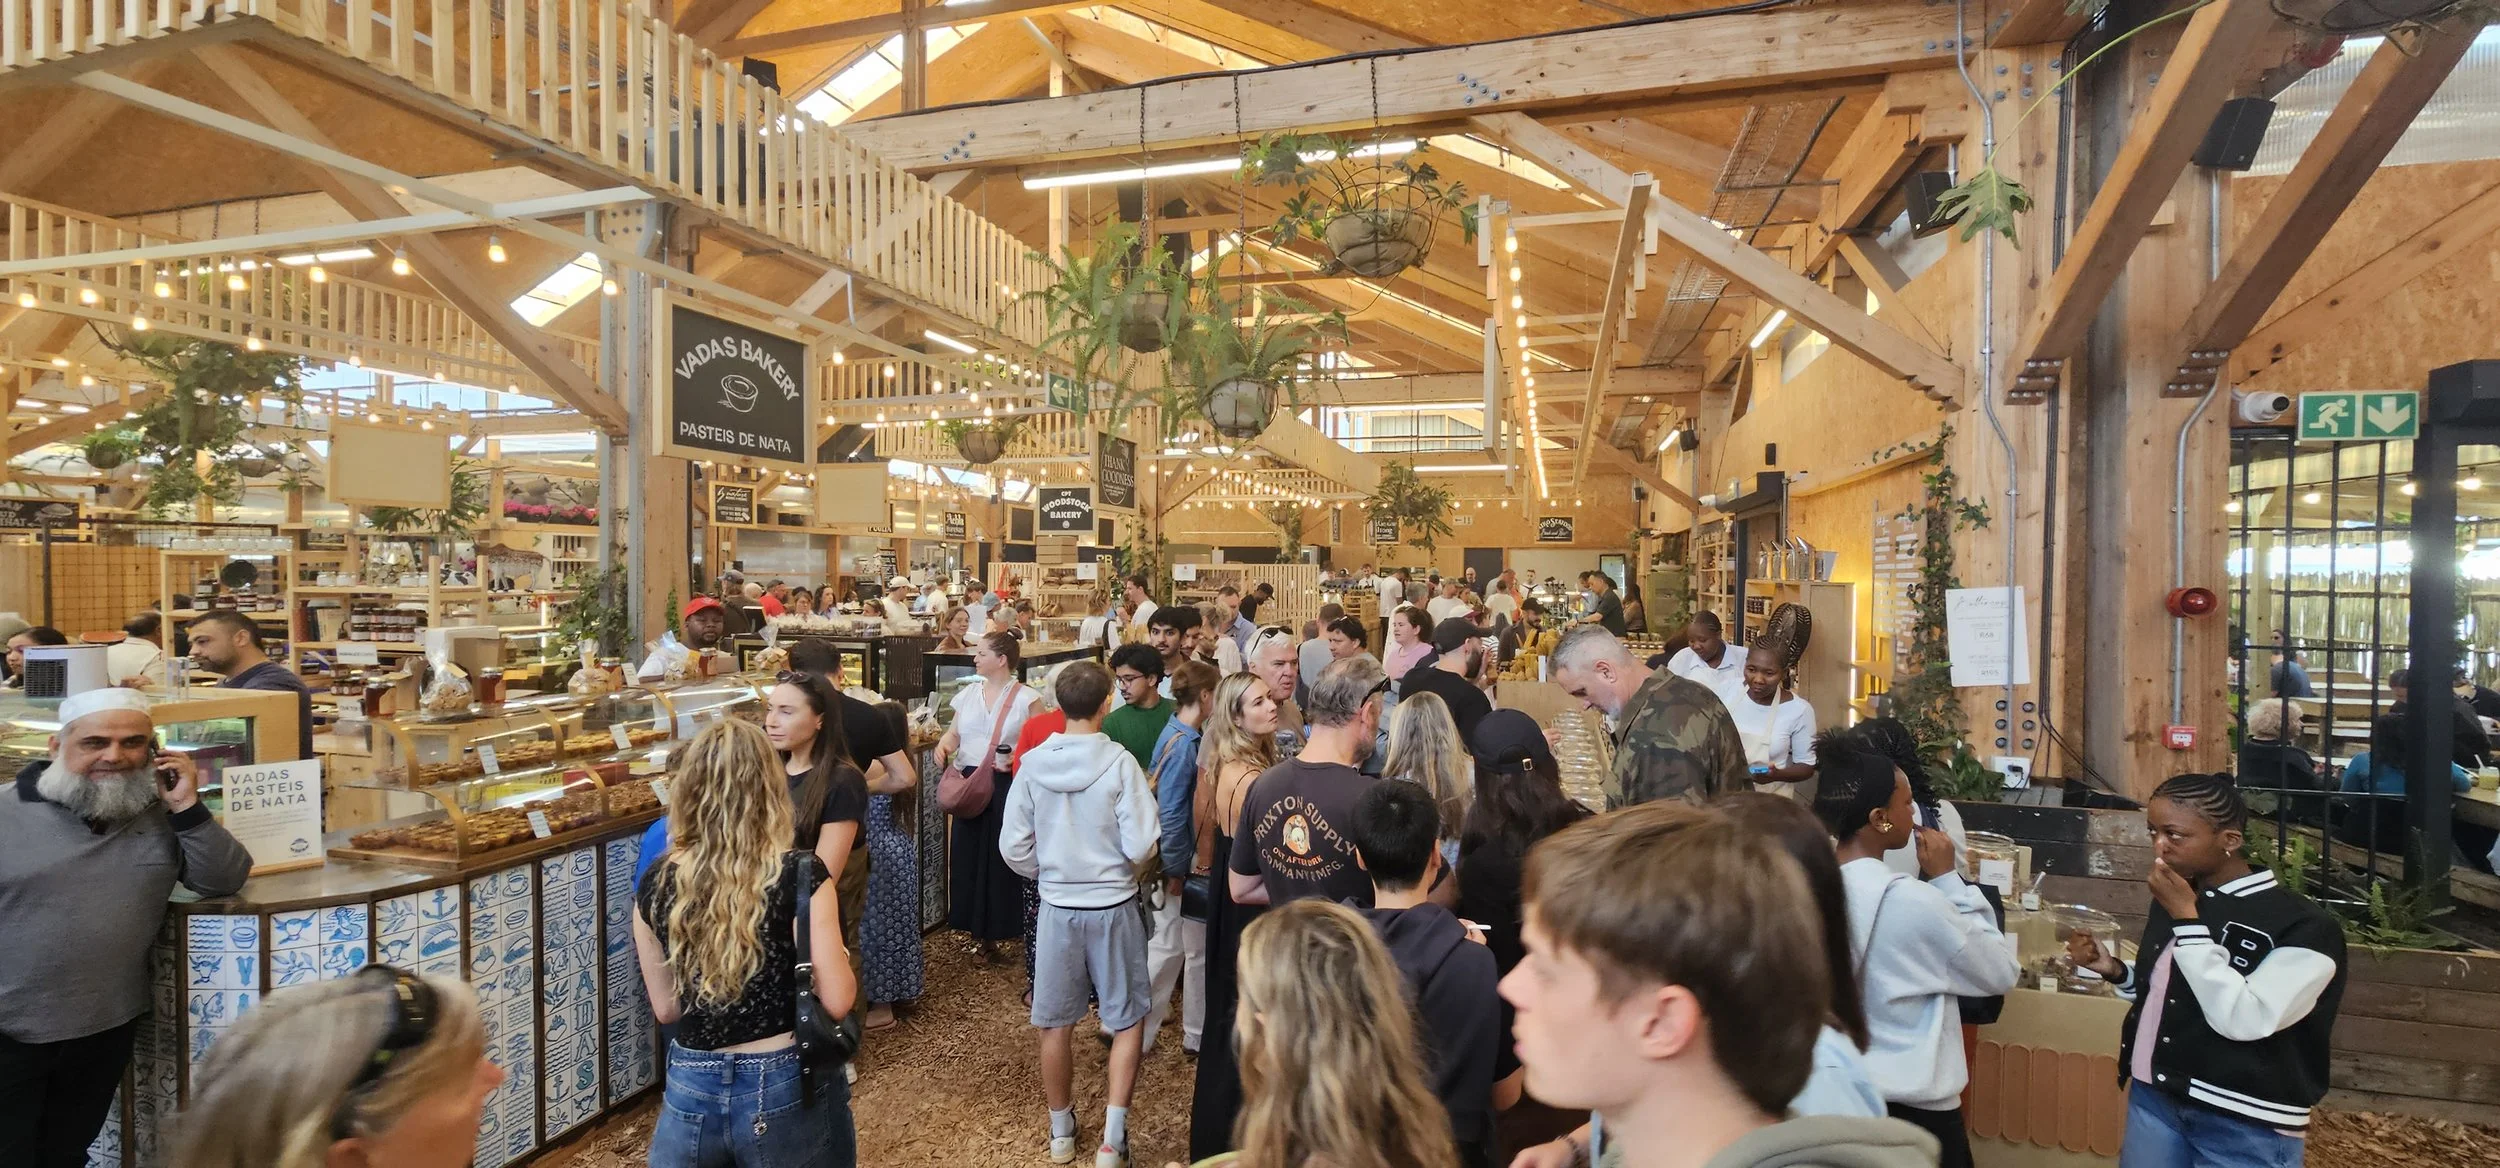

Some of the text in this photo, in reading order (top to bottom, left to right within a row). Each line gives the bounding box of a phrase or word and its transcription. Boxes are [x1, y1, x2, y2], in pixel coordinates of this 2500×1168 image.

[675, 336, 800, 401] VADAS BAKERY
[680, 421, 792, 454] PASTEIS DE NATA
[1104, 454, 1126, 472] THANK
[1102, 468, 1134, 488] GOODNESS
[1041, 497, 1093, 513] WOODSTOCK
[1050, 511, 1082, 519] BAKERY
[230, 769, 290, 785] VADAS
[231, 780, 304, 798] PASTEIS
[232, 793, 307, 812] DE NATA
[1253, 796, 1357, 856] BRIXTON SUPPLY
[1261, 848, 1310, 881] COMPANY
[1315, 860, 1345, 880] MFG.
